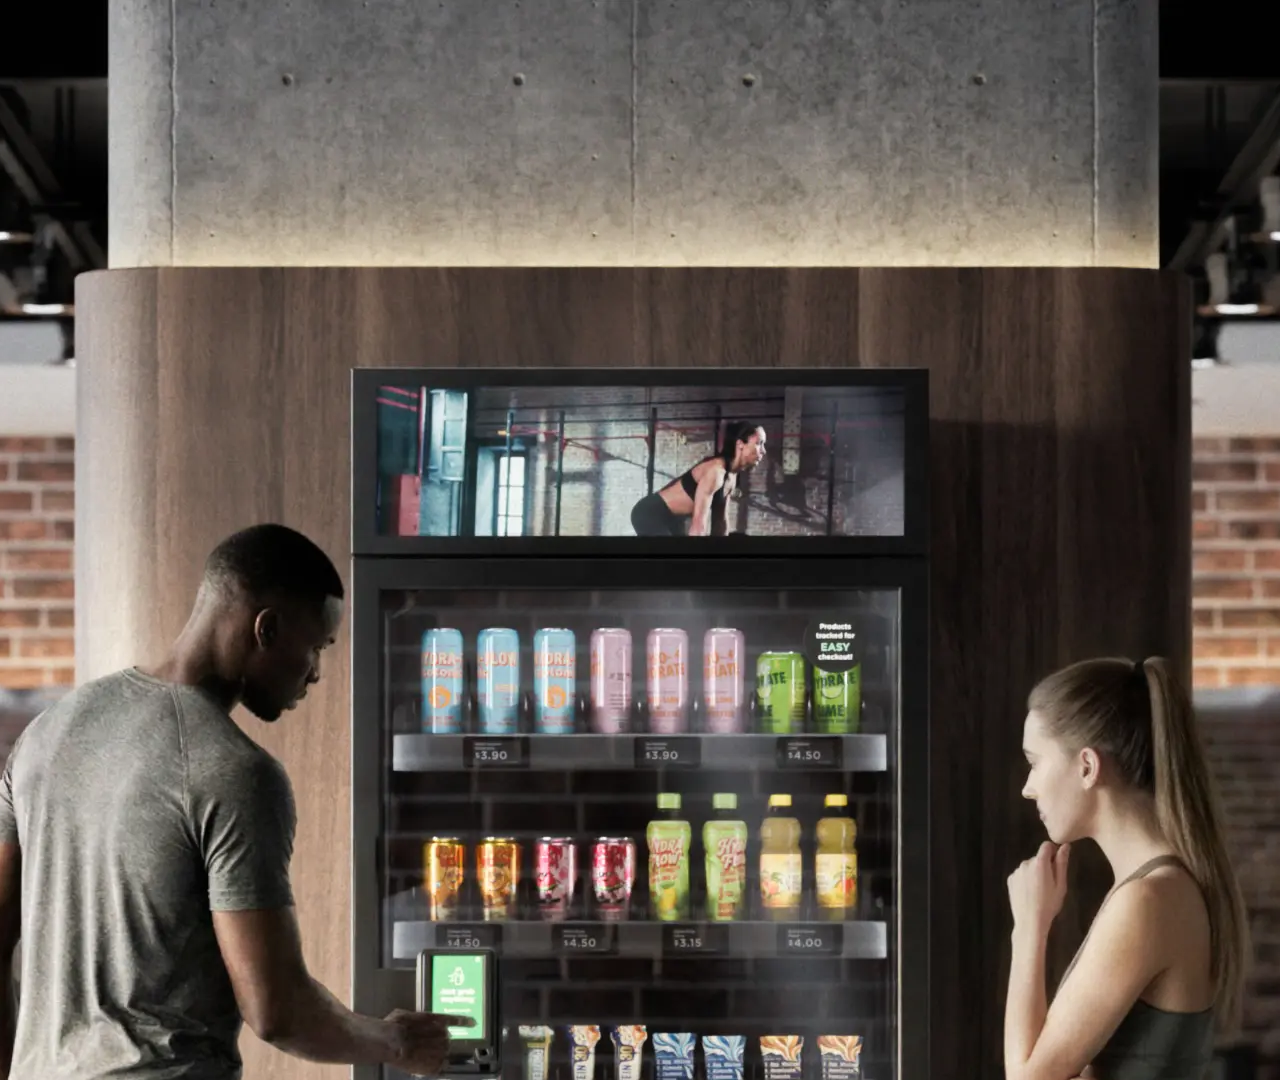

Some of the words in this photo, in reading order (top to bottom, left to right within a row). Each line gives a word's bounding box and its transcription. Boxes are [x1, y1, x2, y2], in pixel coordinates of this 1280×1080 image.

[819, 623, 852, 631] Products
[815, 632, 843, 640] tracked
[844, 632, 855, 640] for
[820, 642, 851, 652] EASY
[817, 653, 853, 661] checkout!
[475, 750, 507, 760] $3.90
[645, 750, 678, 760] $3.90
[787, 750, 821, 760] $4.50
[447, 938, 480, 948] $4.50
[563, 938, 596, 948] $4.50
[674, 938, 702, 948] $3.15
[788, 938, 822, 948] $4.00
[575, 1045, 590, 1061] 30
[619, 1045, 634, 1061] 30
